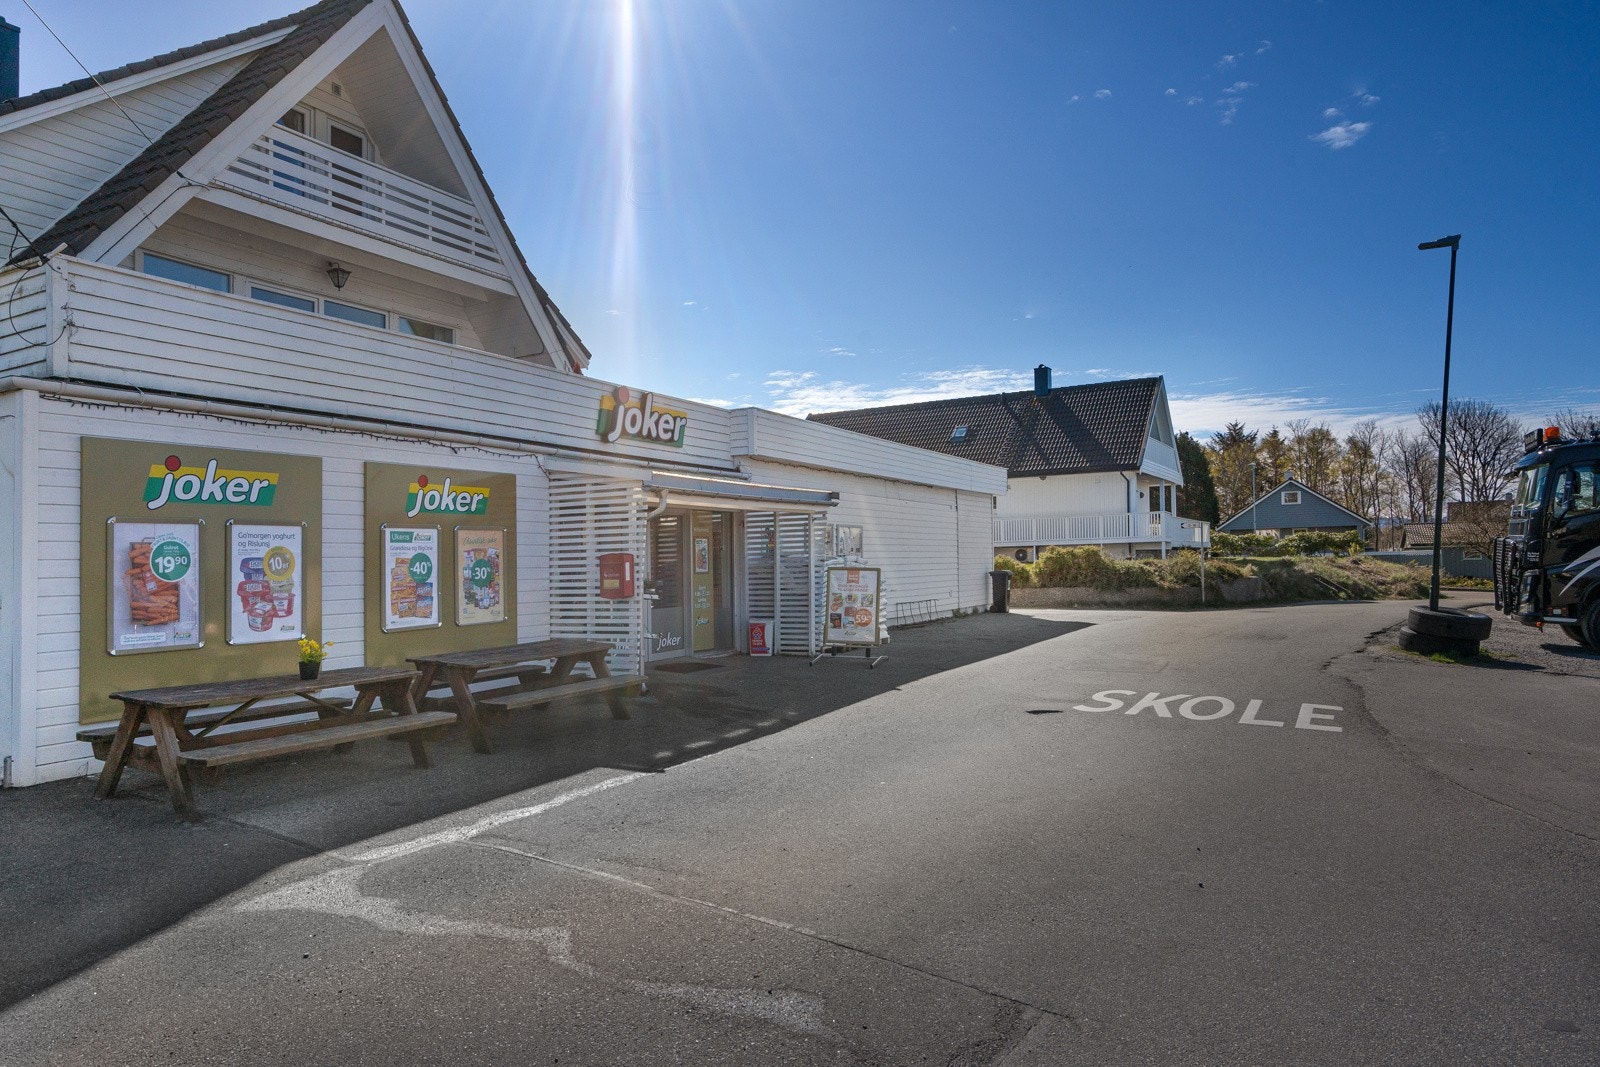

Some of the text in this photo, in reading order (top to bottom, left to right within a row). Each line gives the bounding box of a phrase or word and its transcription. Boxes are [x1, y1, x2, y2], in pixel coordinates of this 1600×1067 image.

[607, 386, 687, 442] joker
[147, 455, 269, 510] joker
[408, 475, 484, 517] joker
[272, 532, 295, 540] yoghurt
[656, 632, 682, 651] joker
[1072, 689, 1345, 733] SKOLE
